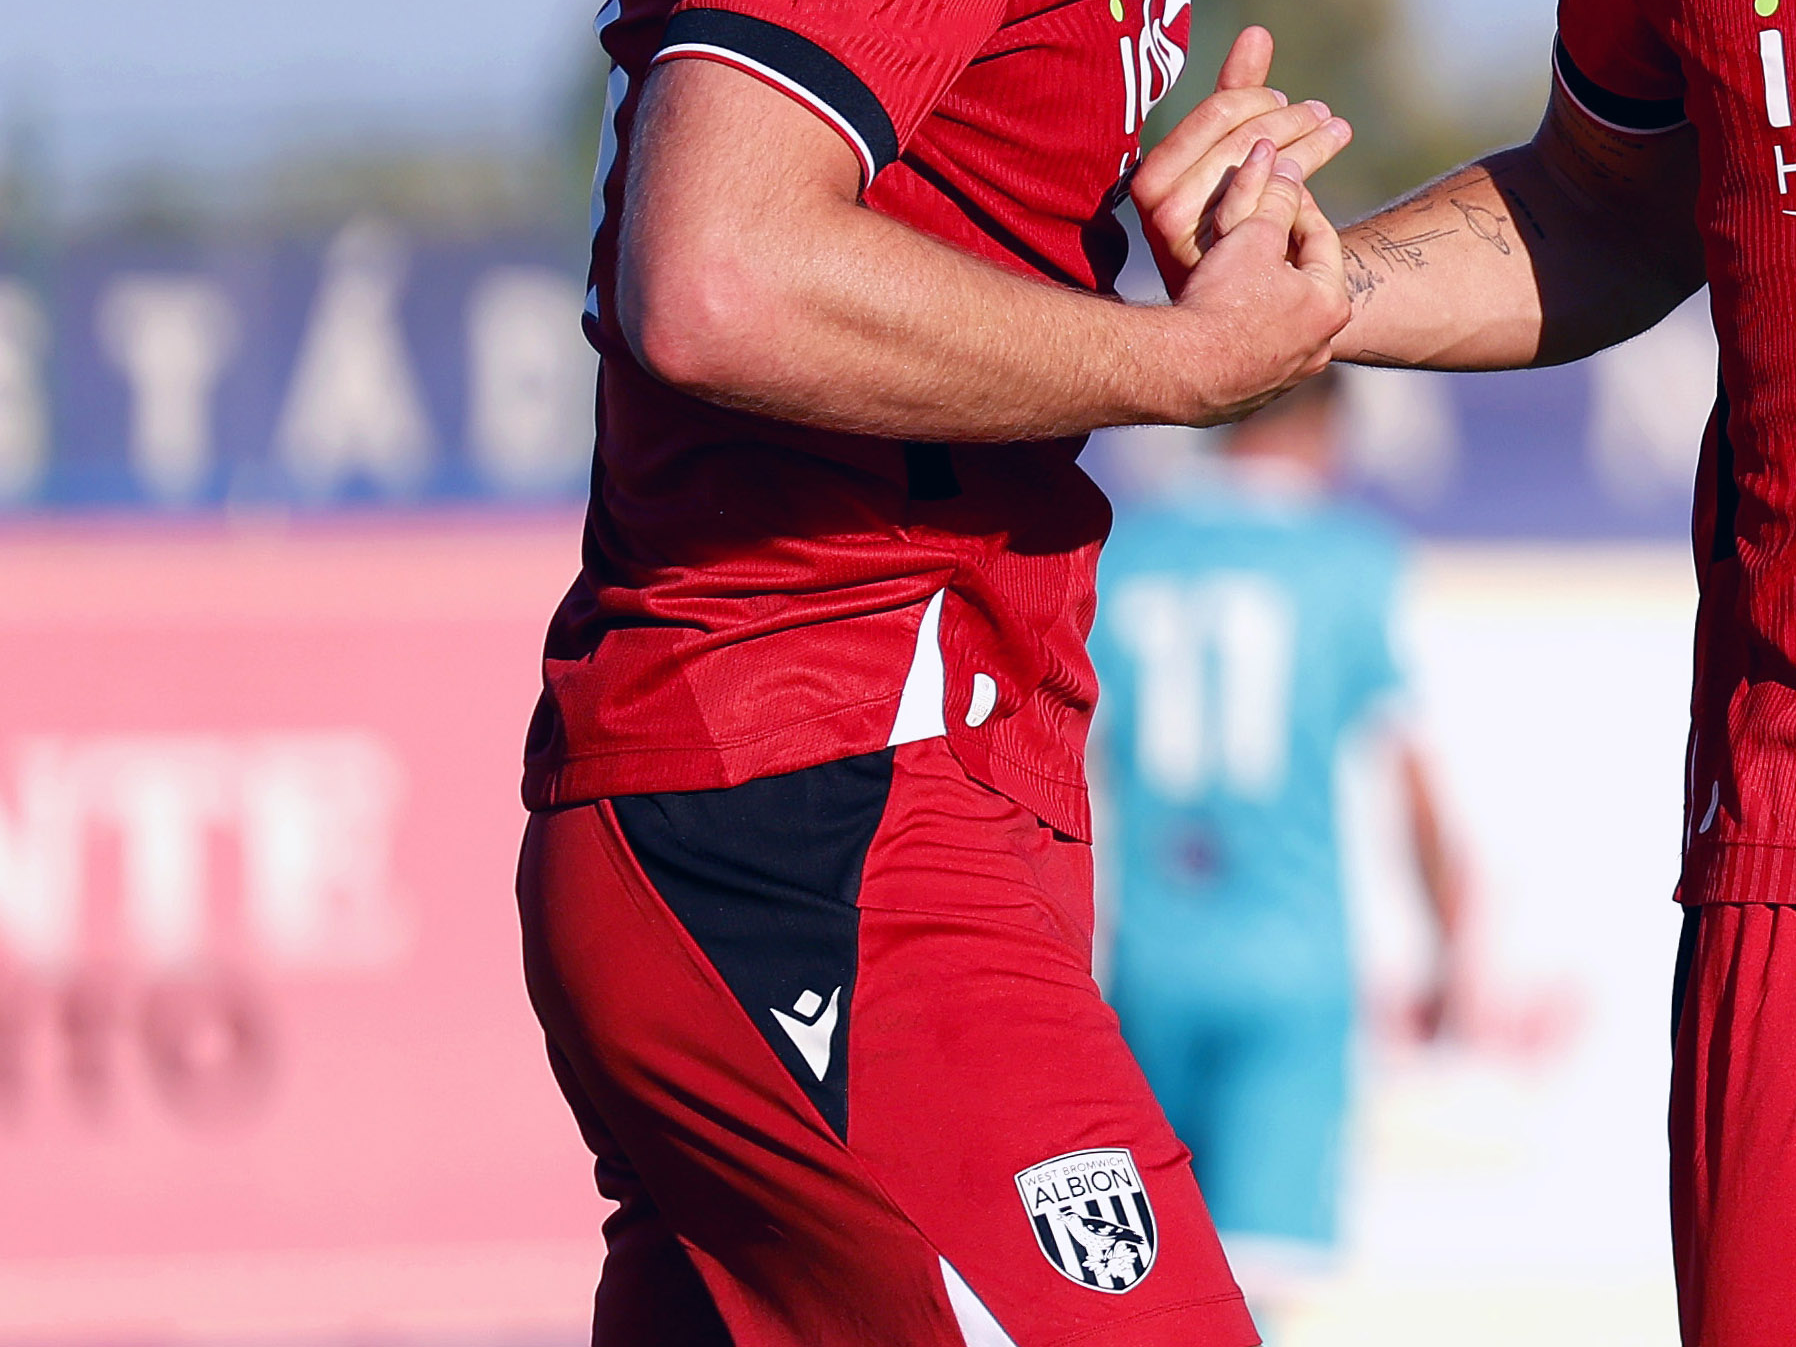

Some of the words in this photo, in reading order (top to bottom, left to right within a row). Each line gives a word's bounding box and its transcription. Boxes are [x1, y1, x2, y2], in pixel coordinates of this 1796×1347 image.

[1112, 573, 1294, 800] 11
[1025, 1169, 1061, 1186] WEST
[1063, 1157, 1125, 1175] BROMWICH
[1035, 1168, 1133, 1209] ALBION
